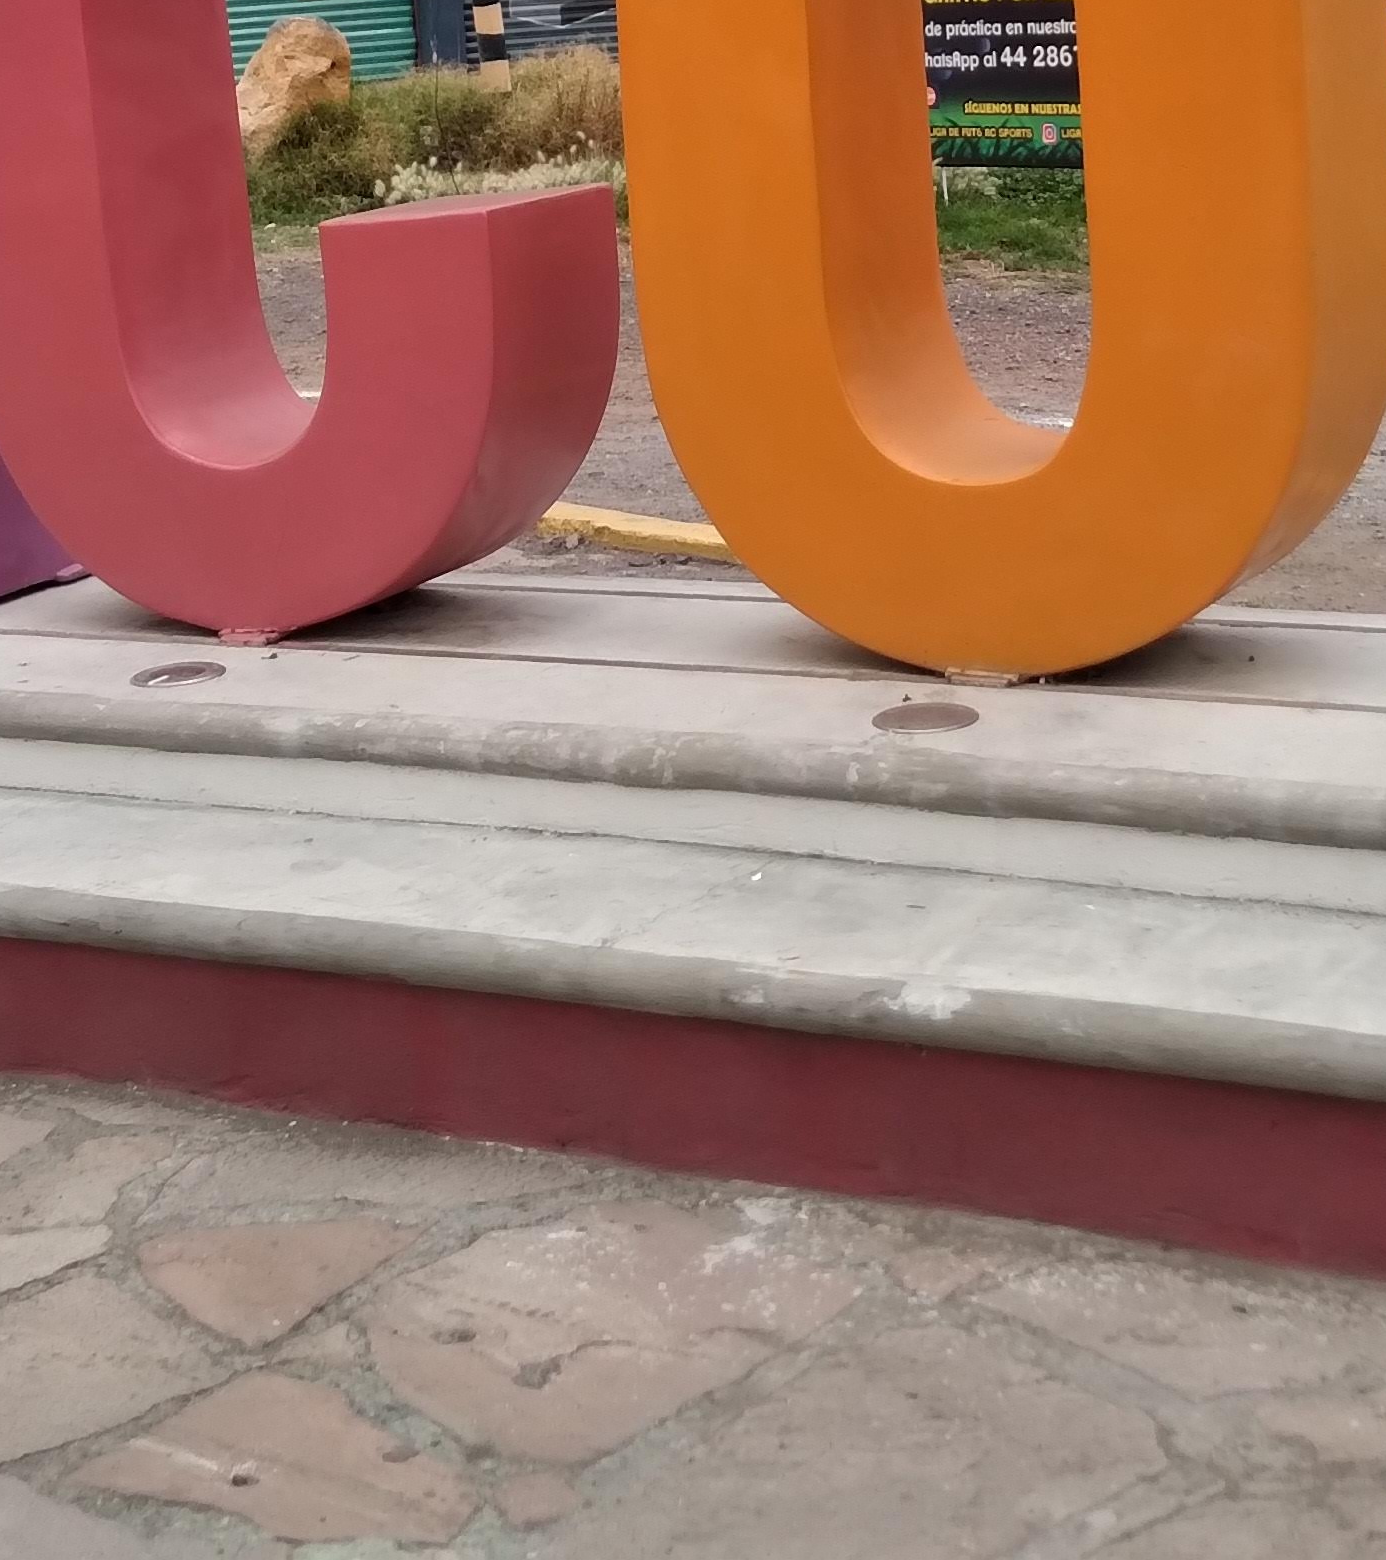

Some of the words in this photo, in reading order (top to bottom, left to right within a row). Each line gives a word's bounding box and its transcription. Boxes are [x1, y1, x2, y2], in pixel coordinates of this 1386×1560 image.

[925, 21, 942, 37] de
[945, 19, 1002, 39] práctica
[1005, 22, 1023, 35] en
[924, 51, 979, 71] hatsApp
[983, 51, 997, 67] al
[1000, 45, 1026, 67] 44
[1032, 45, 1077, 67] 286
[964, 101, 1012, 114] SÍGUENOS
[1014, 103, 1029, 114] EN
